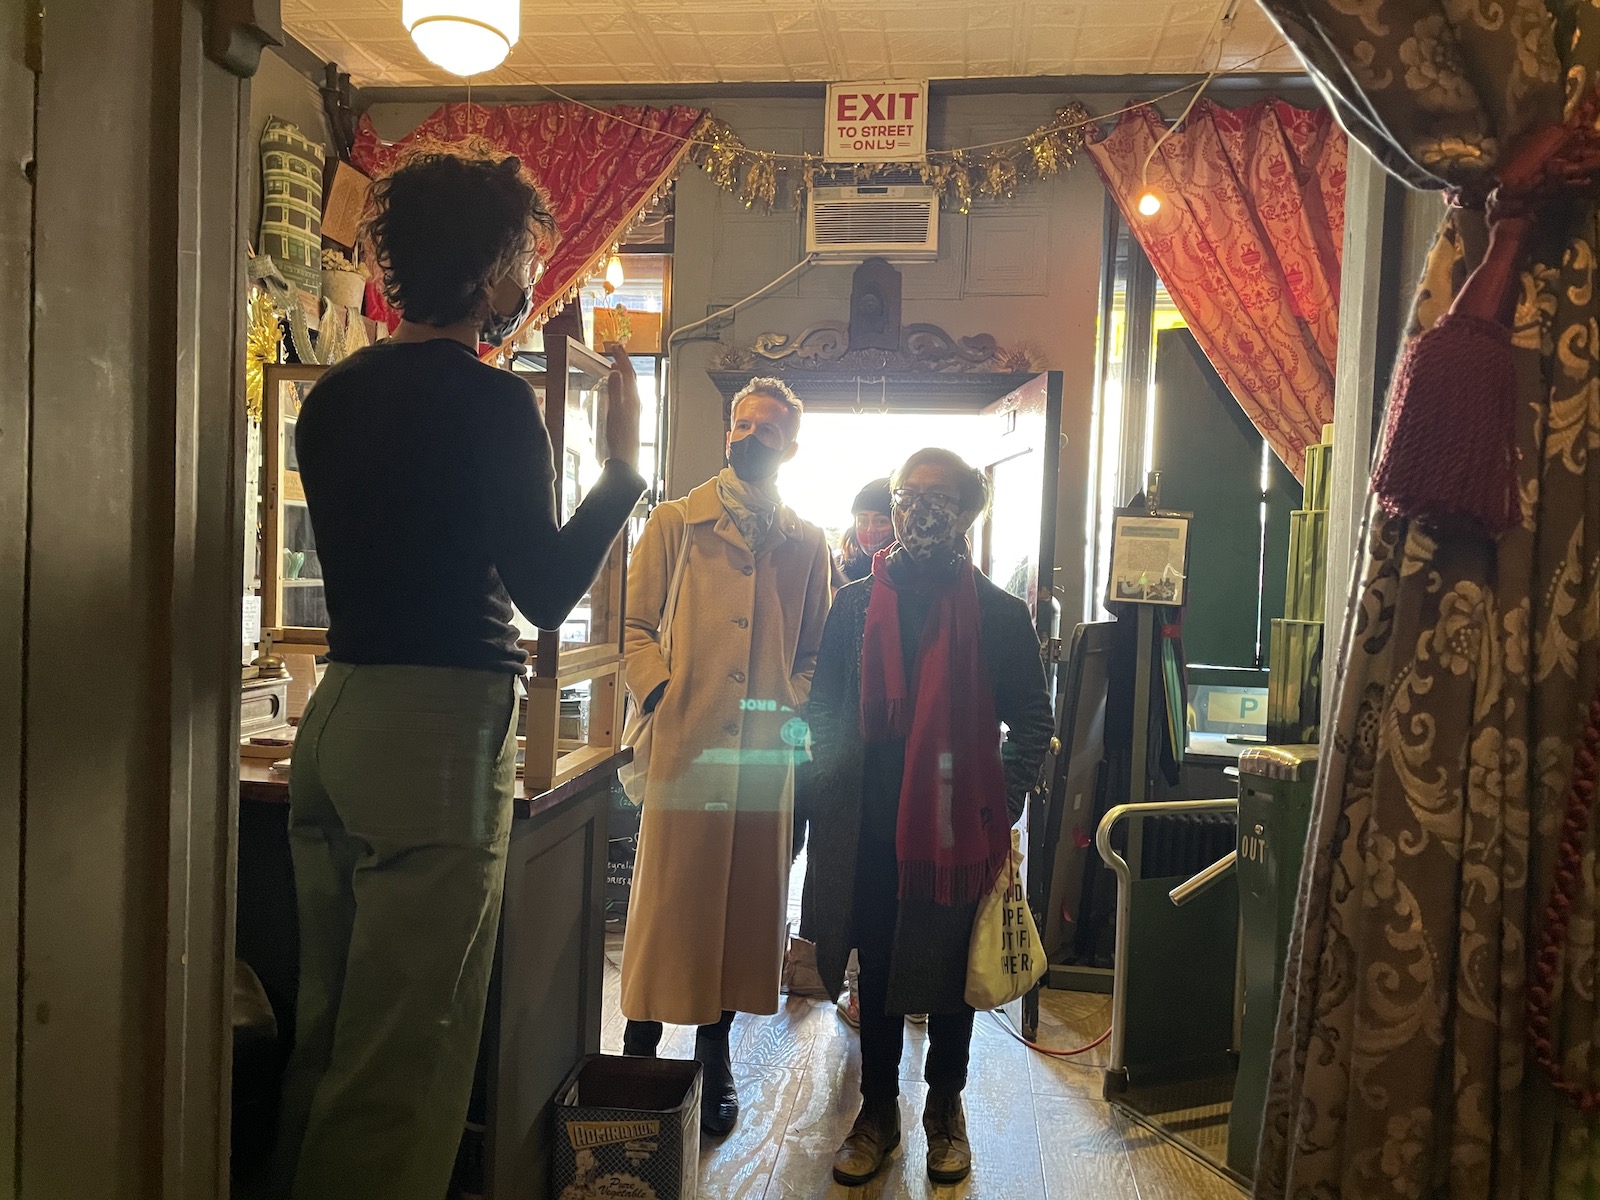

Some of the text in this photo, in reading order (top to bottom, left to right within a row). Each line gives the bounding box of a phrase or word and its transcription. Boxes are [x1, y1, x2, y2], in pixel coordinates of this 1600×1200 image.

[837, 93, 919, 121] EXIT
[838, 125, 914, 137] TO STREET
[853, 139, 895, 150] ONLY
[1240, 697, 1258, 719] P
[1241, 835, 1265, 864] OUT
[574, 1122, 656, 1146] ADMIRATION
[598, 1185, 647, 1199] Vegetable
[610, 1177, 635, 1189] Pure
